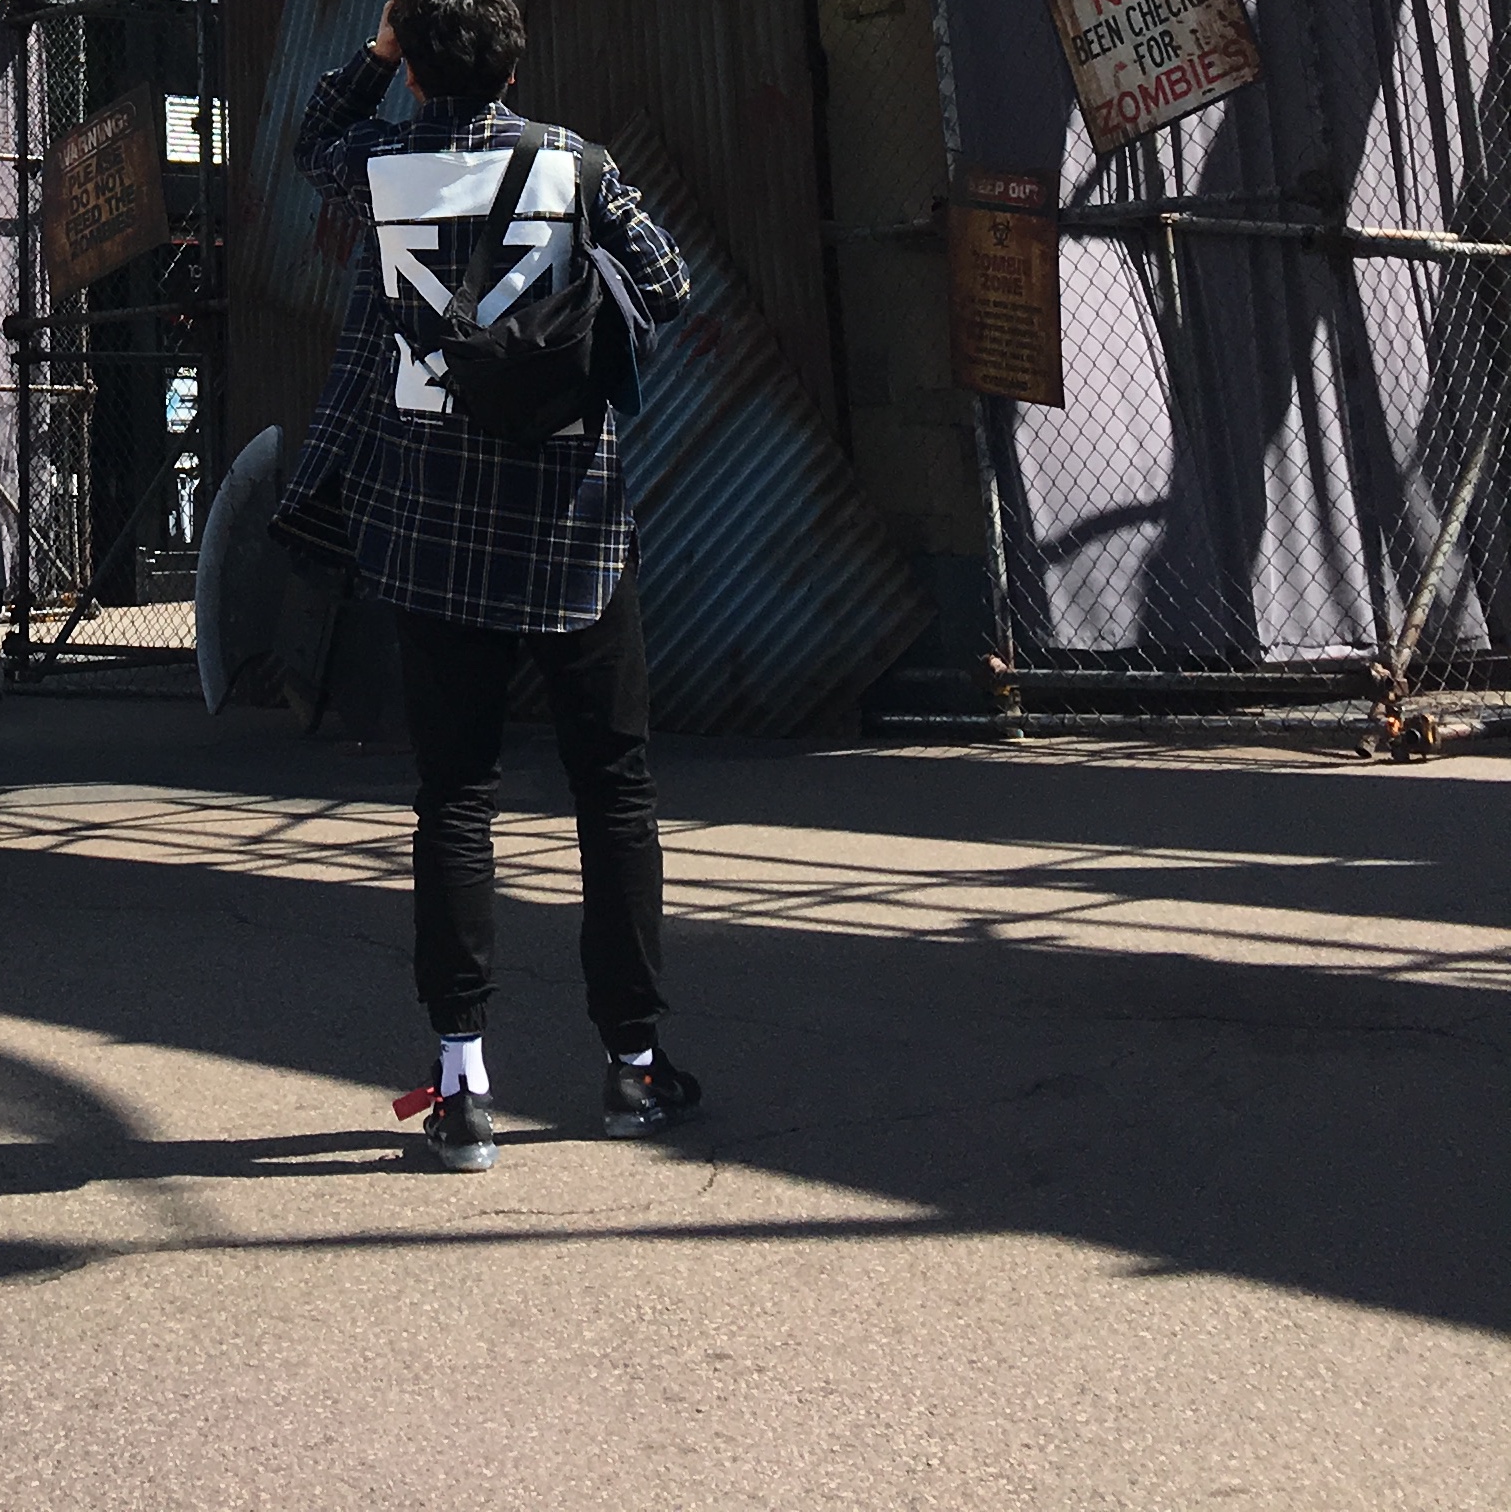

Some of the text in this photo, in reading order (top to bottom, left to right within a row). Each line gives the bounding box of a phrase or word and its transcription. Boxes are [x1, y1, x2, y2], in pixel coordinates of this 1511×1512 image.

[1072, 19, 1125, 66] BEEN
[1134, 30, 1182, 75] FOR
[1093, 41, 1250, 136] ZOMBIES
[69, 166, 126, 214] DO NOT
[66, 183, 136, 246] FEED THE
